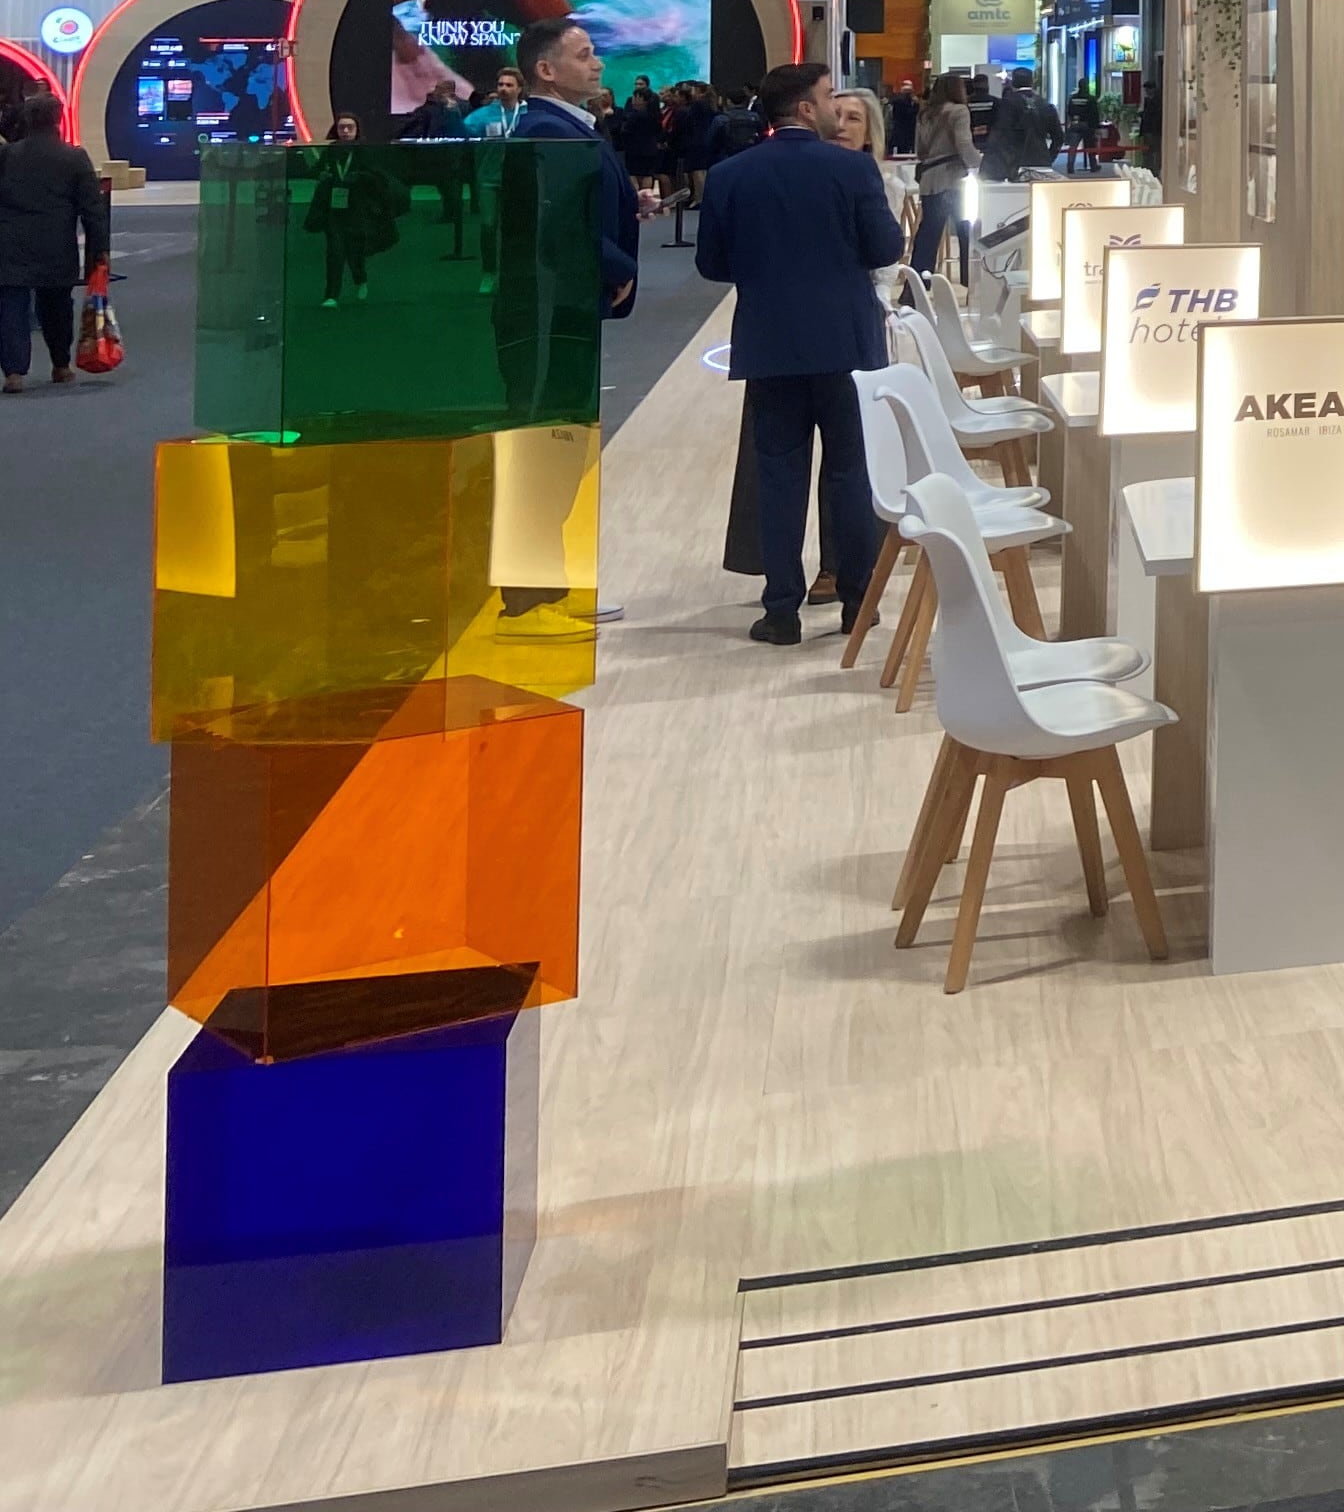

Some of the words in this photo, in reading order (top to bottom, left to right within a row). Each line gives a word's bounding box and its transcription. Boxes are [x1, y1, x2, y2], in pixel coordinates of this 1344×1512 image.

[420, 21, 468, 35] THINK
[470, 20, 505, 34] YOU
[418, 33, 468, 46] KNOW
[1168, 288, 1239, 314] THB
[1266, 426, 1310, 439] ROSAMAR
[1318, 424, 1342, 437] IBIZA
